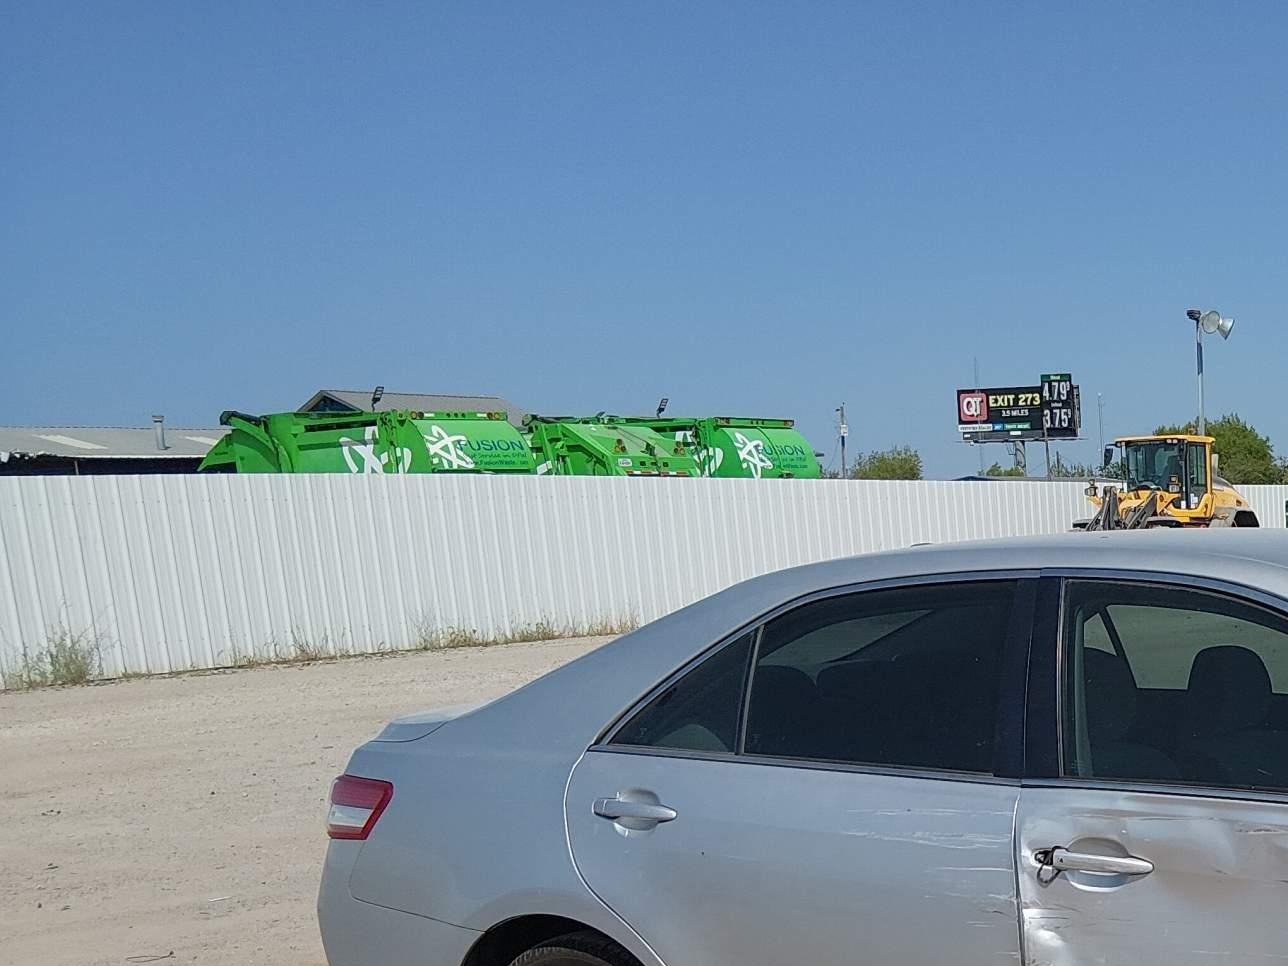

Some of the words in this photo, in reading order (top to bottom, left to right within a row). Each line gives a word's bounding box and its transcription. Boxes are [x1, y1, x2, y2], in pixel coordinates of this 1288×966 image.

[962, 397, 983, 417] QT
[989, 394, 1015, 407] EXIT
[1018, 393, 1041, 405] 273
[1011, 408, 1029, 417] MILES
